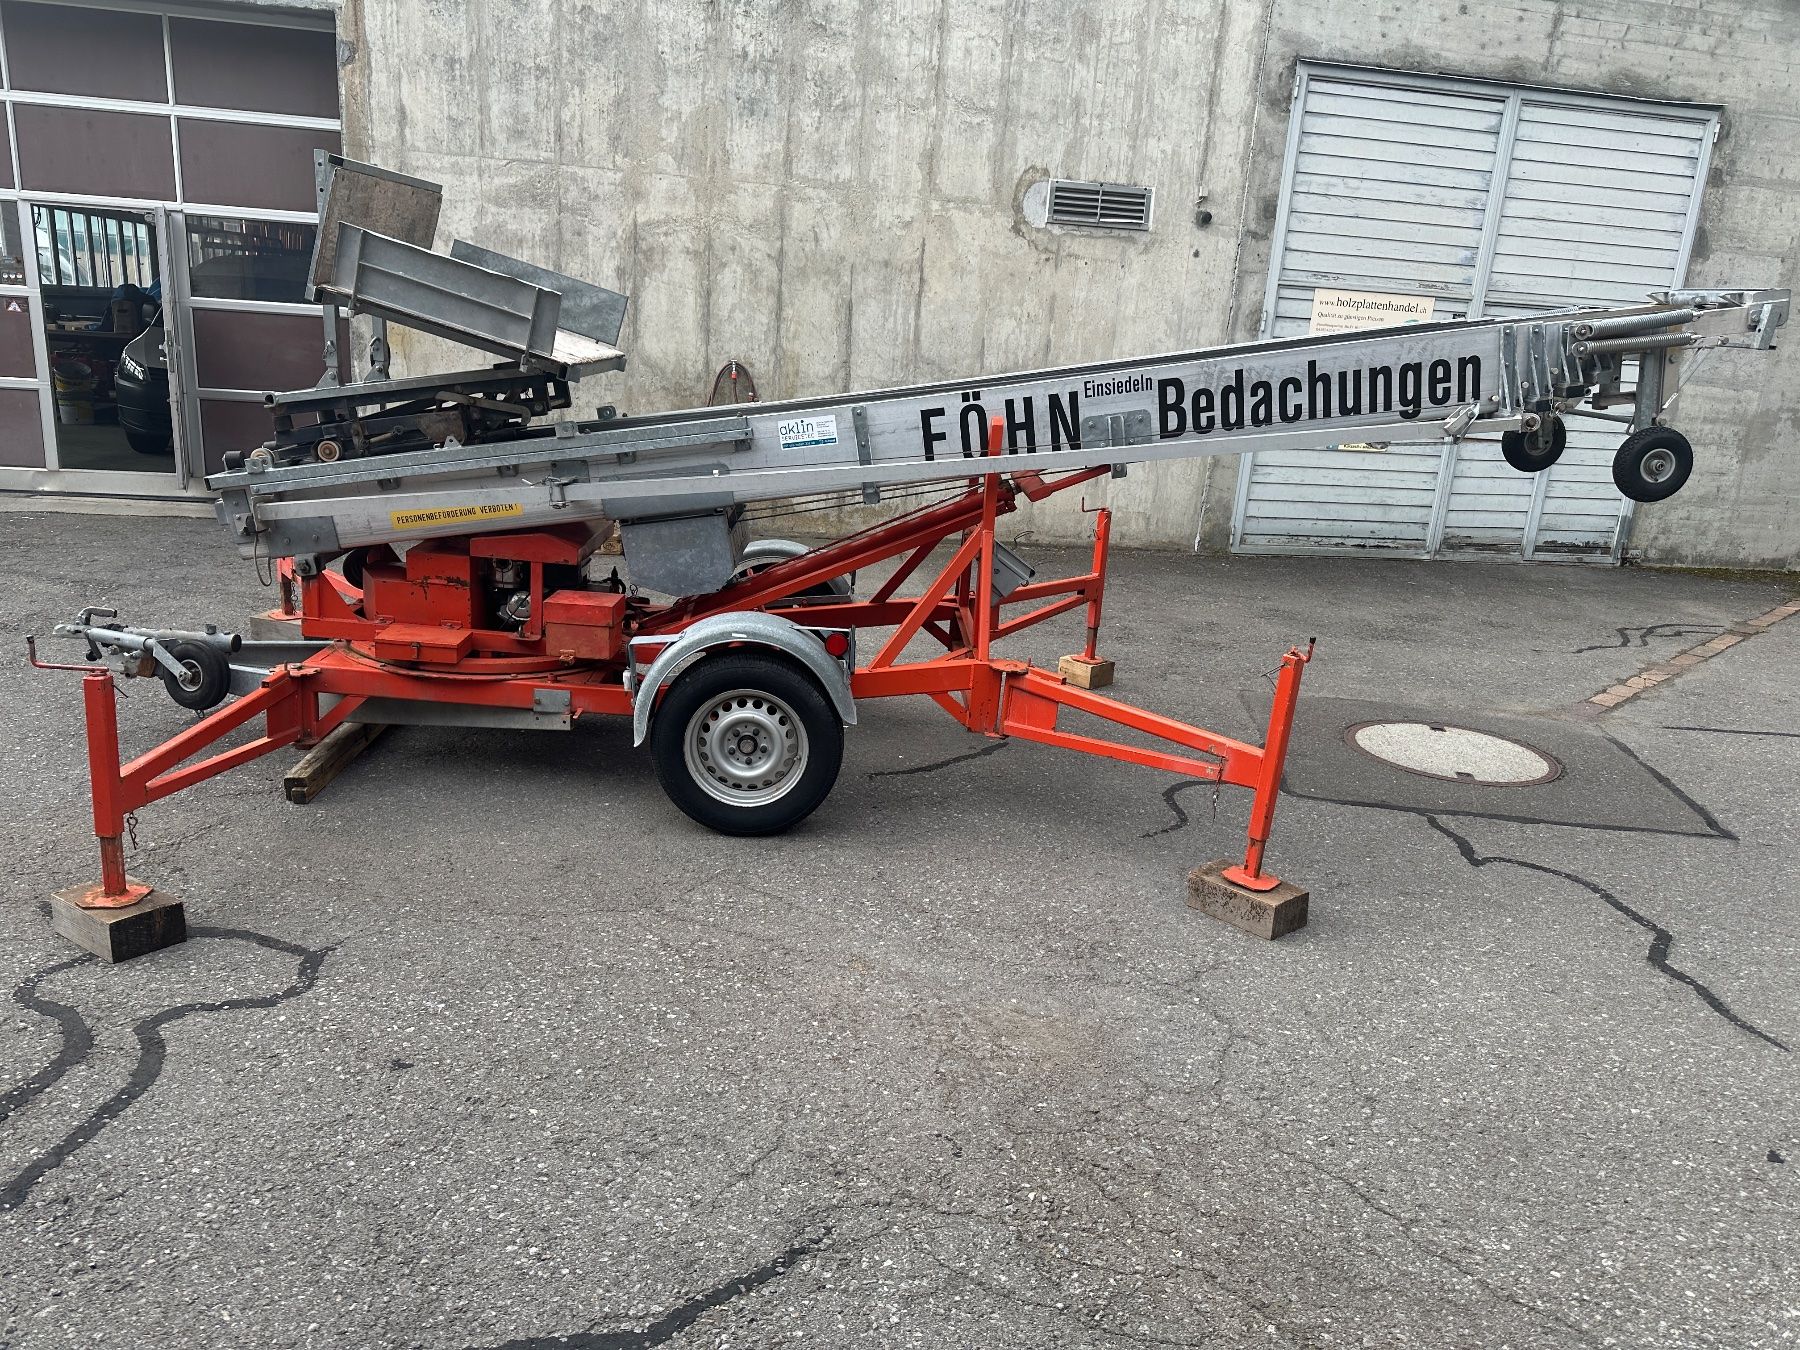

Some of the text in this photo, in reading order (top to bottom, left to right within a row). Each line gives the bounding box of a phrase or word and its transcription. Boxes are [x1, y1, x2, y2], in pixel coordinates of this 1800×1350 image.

[1319, 297, 1427, 314] www.holzplattenhandel.ch
[920, 354, 1482, 461] FÖHN Einsiedeln Bedachungen
[780, 420, 814, 435] aklin
[396, 507, 477, 524] PERSONENBEFÖRDERUNG
